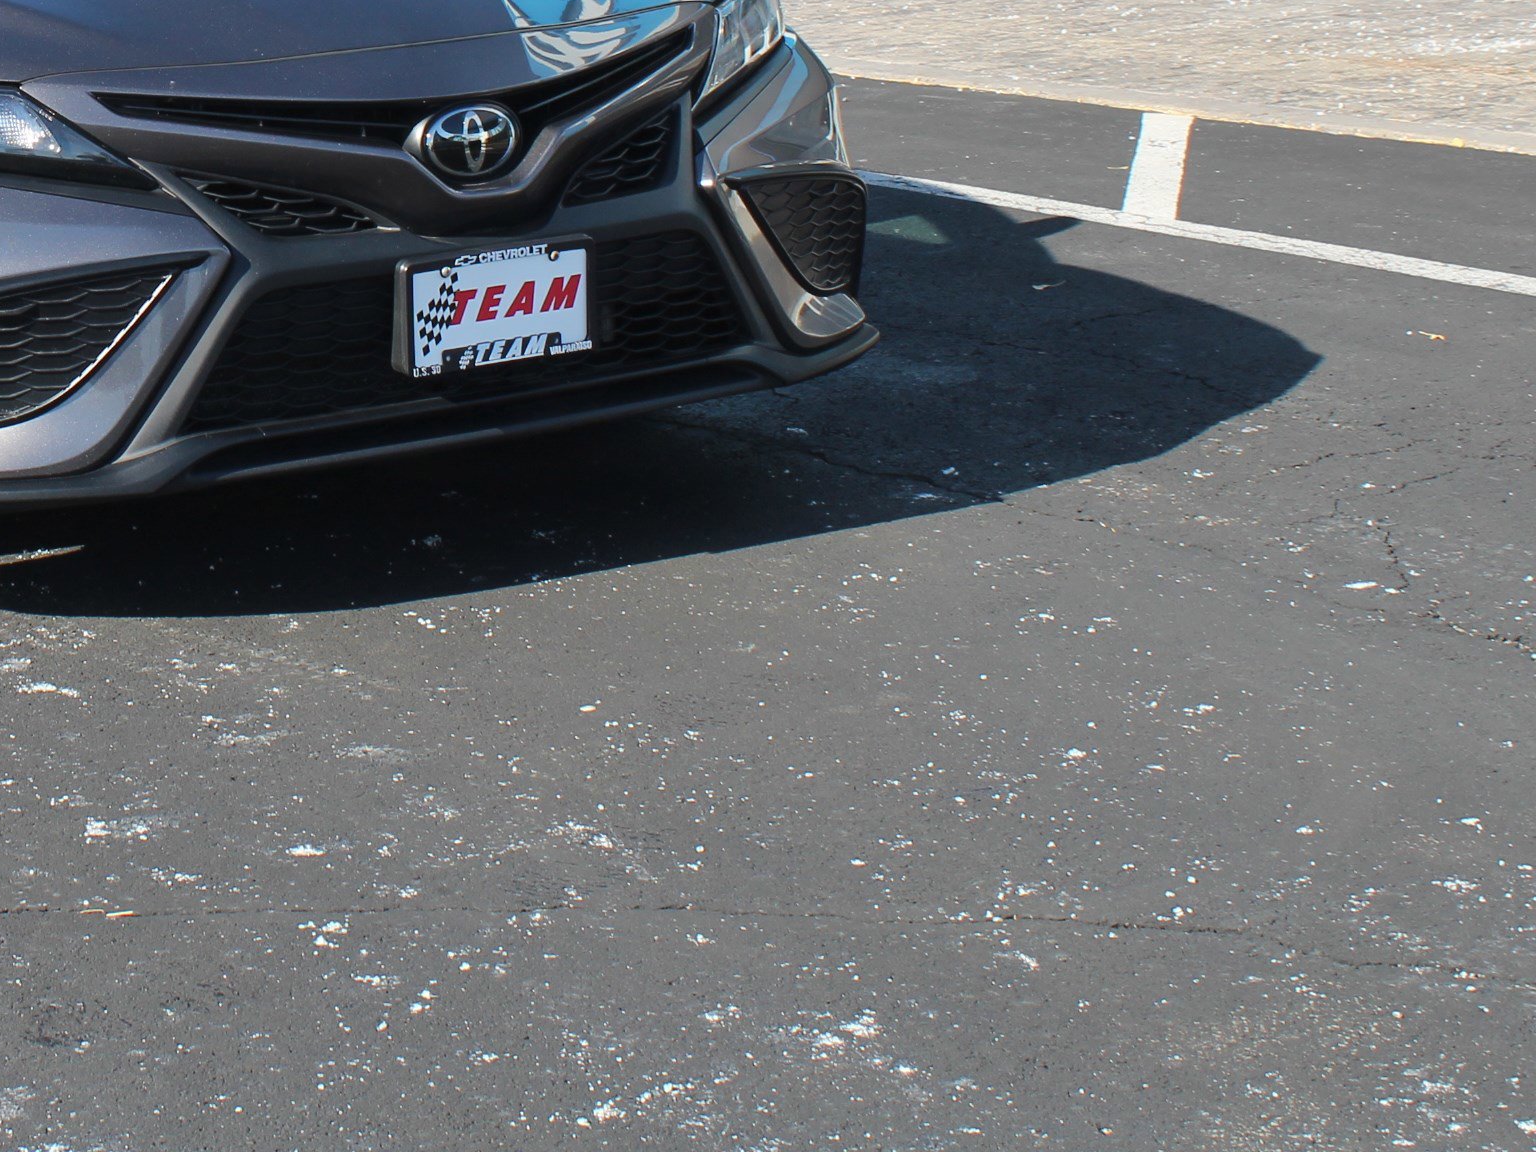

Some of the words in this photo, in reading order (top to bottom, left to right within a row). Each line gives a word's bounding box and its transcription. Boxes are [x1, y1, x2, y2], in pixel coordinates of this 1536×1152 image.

[479, 244, 547, 263] CHEVROLET
[449, 274, 581, 325] TEAM
[475, 335, 547, 363] TEAM
